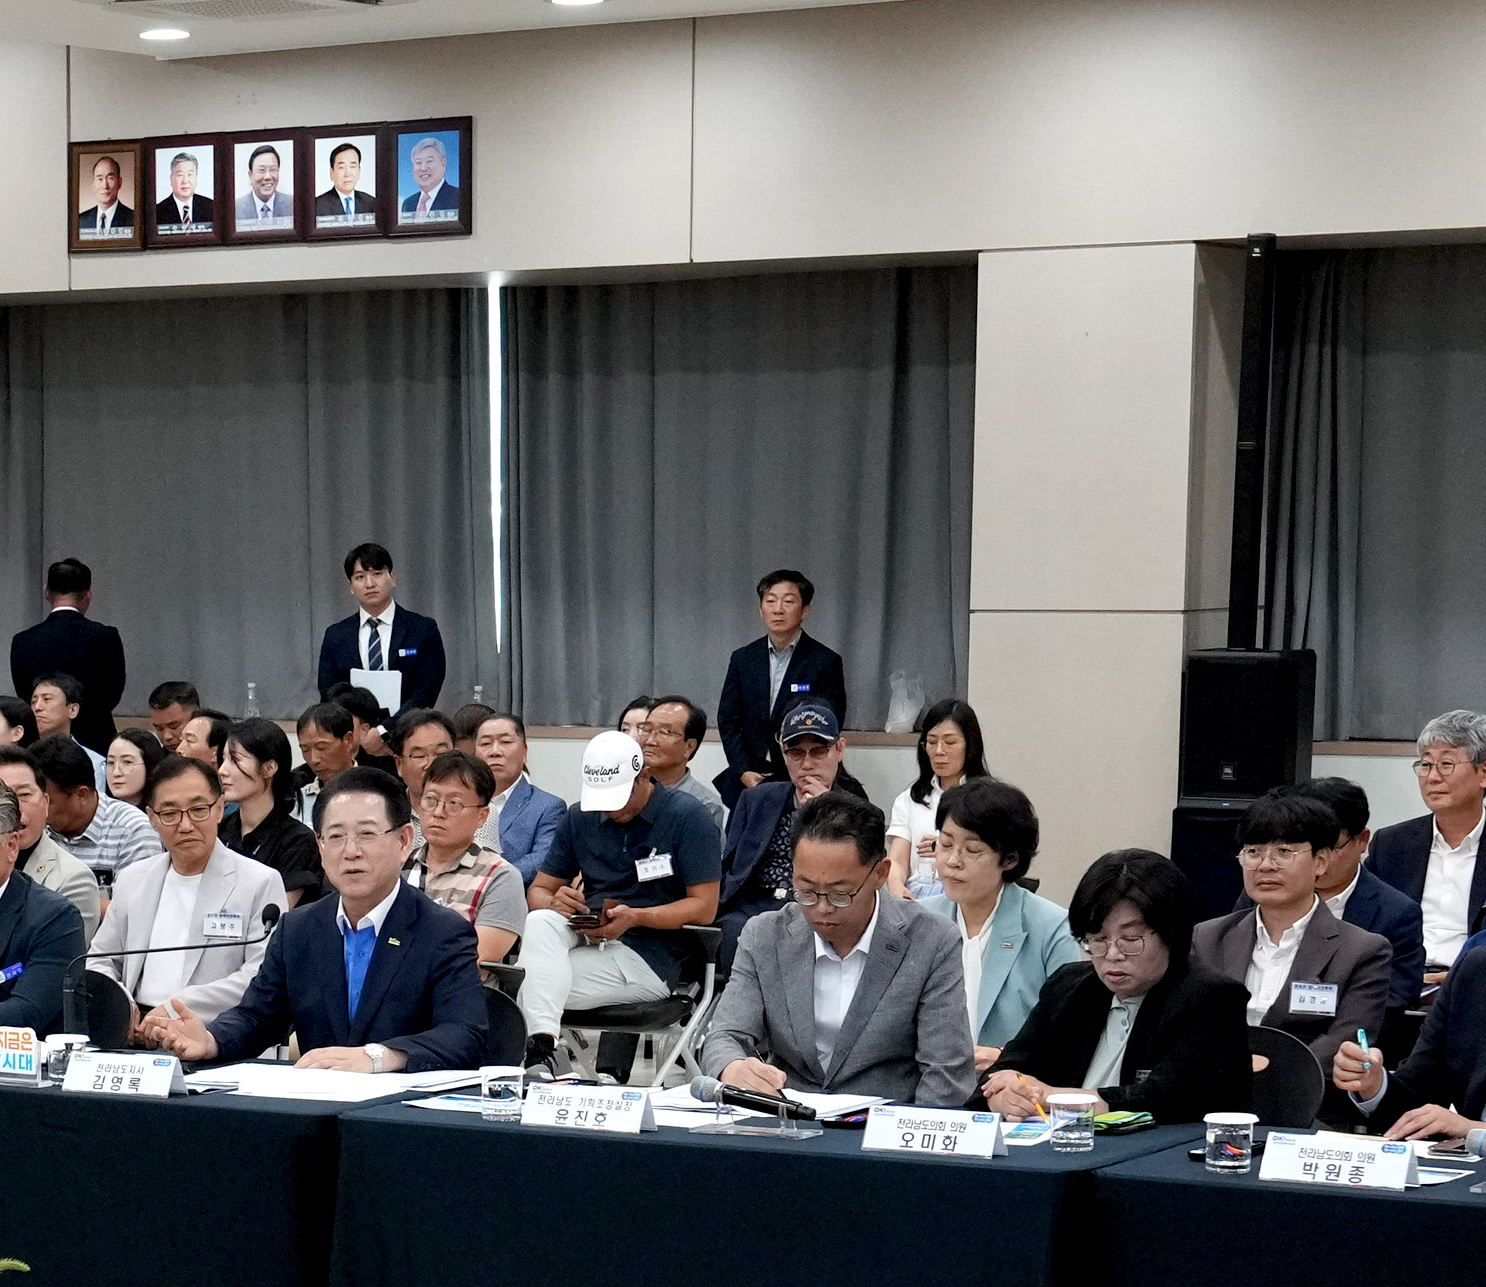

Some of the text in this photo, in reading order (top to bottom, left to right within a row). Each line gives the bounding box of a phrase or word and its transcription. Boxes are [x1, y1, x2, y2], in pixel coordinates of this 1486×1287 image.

[583, 764, 620, 776] Cleveland
[96, 1063, 145, 1075] 전라남도지사
[92, 1075, 141, 1092] 김영록
[537, 1094, 633, 1111] 전라남도 기획조정실장
[555, 1108, 608, 1127] 윤진호
[897, 1118, 968, 1133] 전라남도의회 의원
[899, 1132, 958, 1152] 오미화
[1298, 1147, 1376, 1164] 전라남도의회 의원
[1302, 1161, 1365, 1184] 박원종
